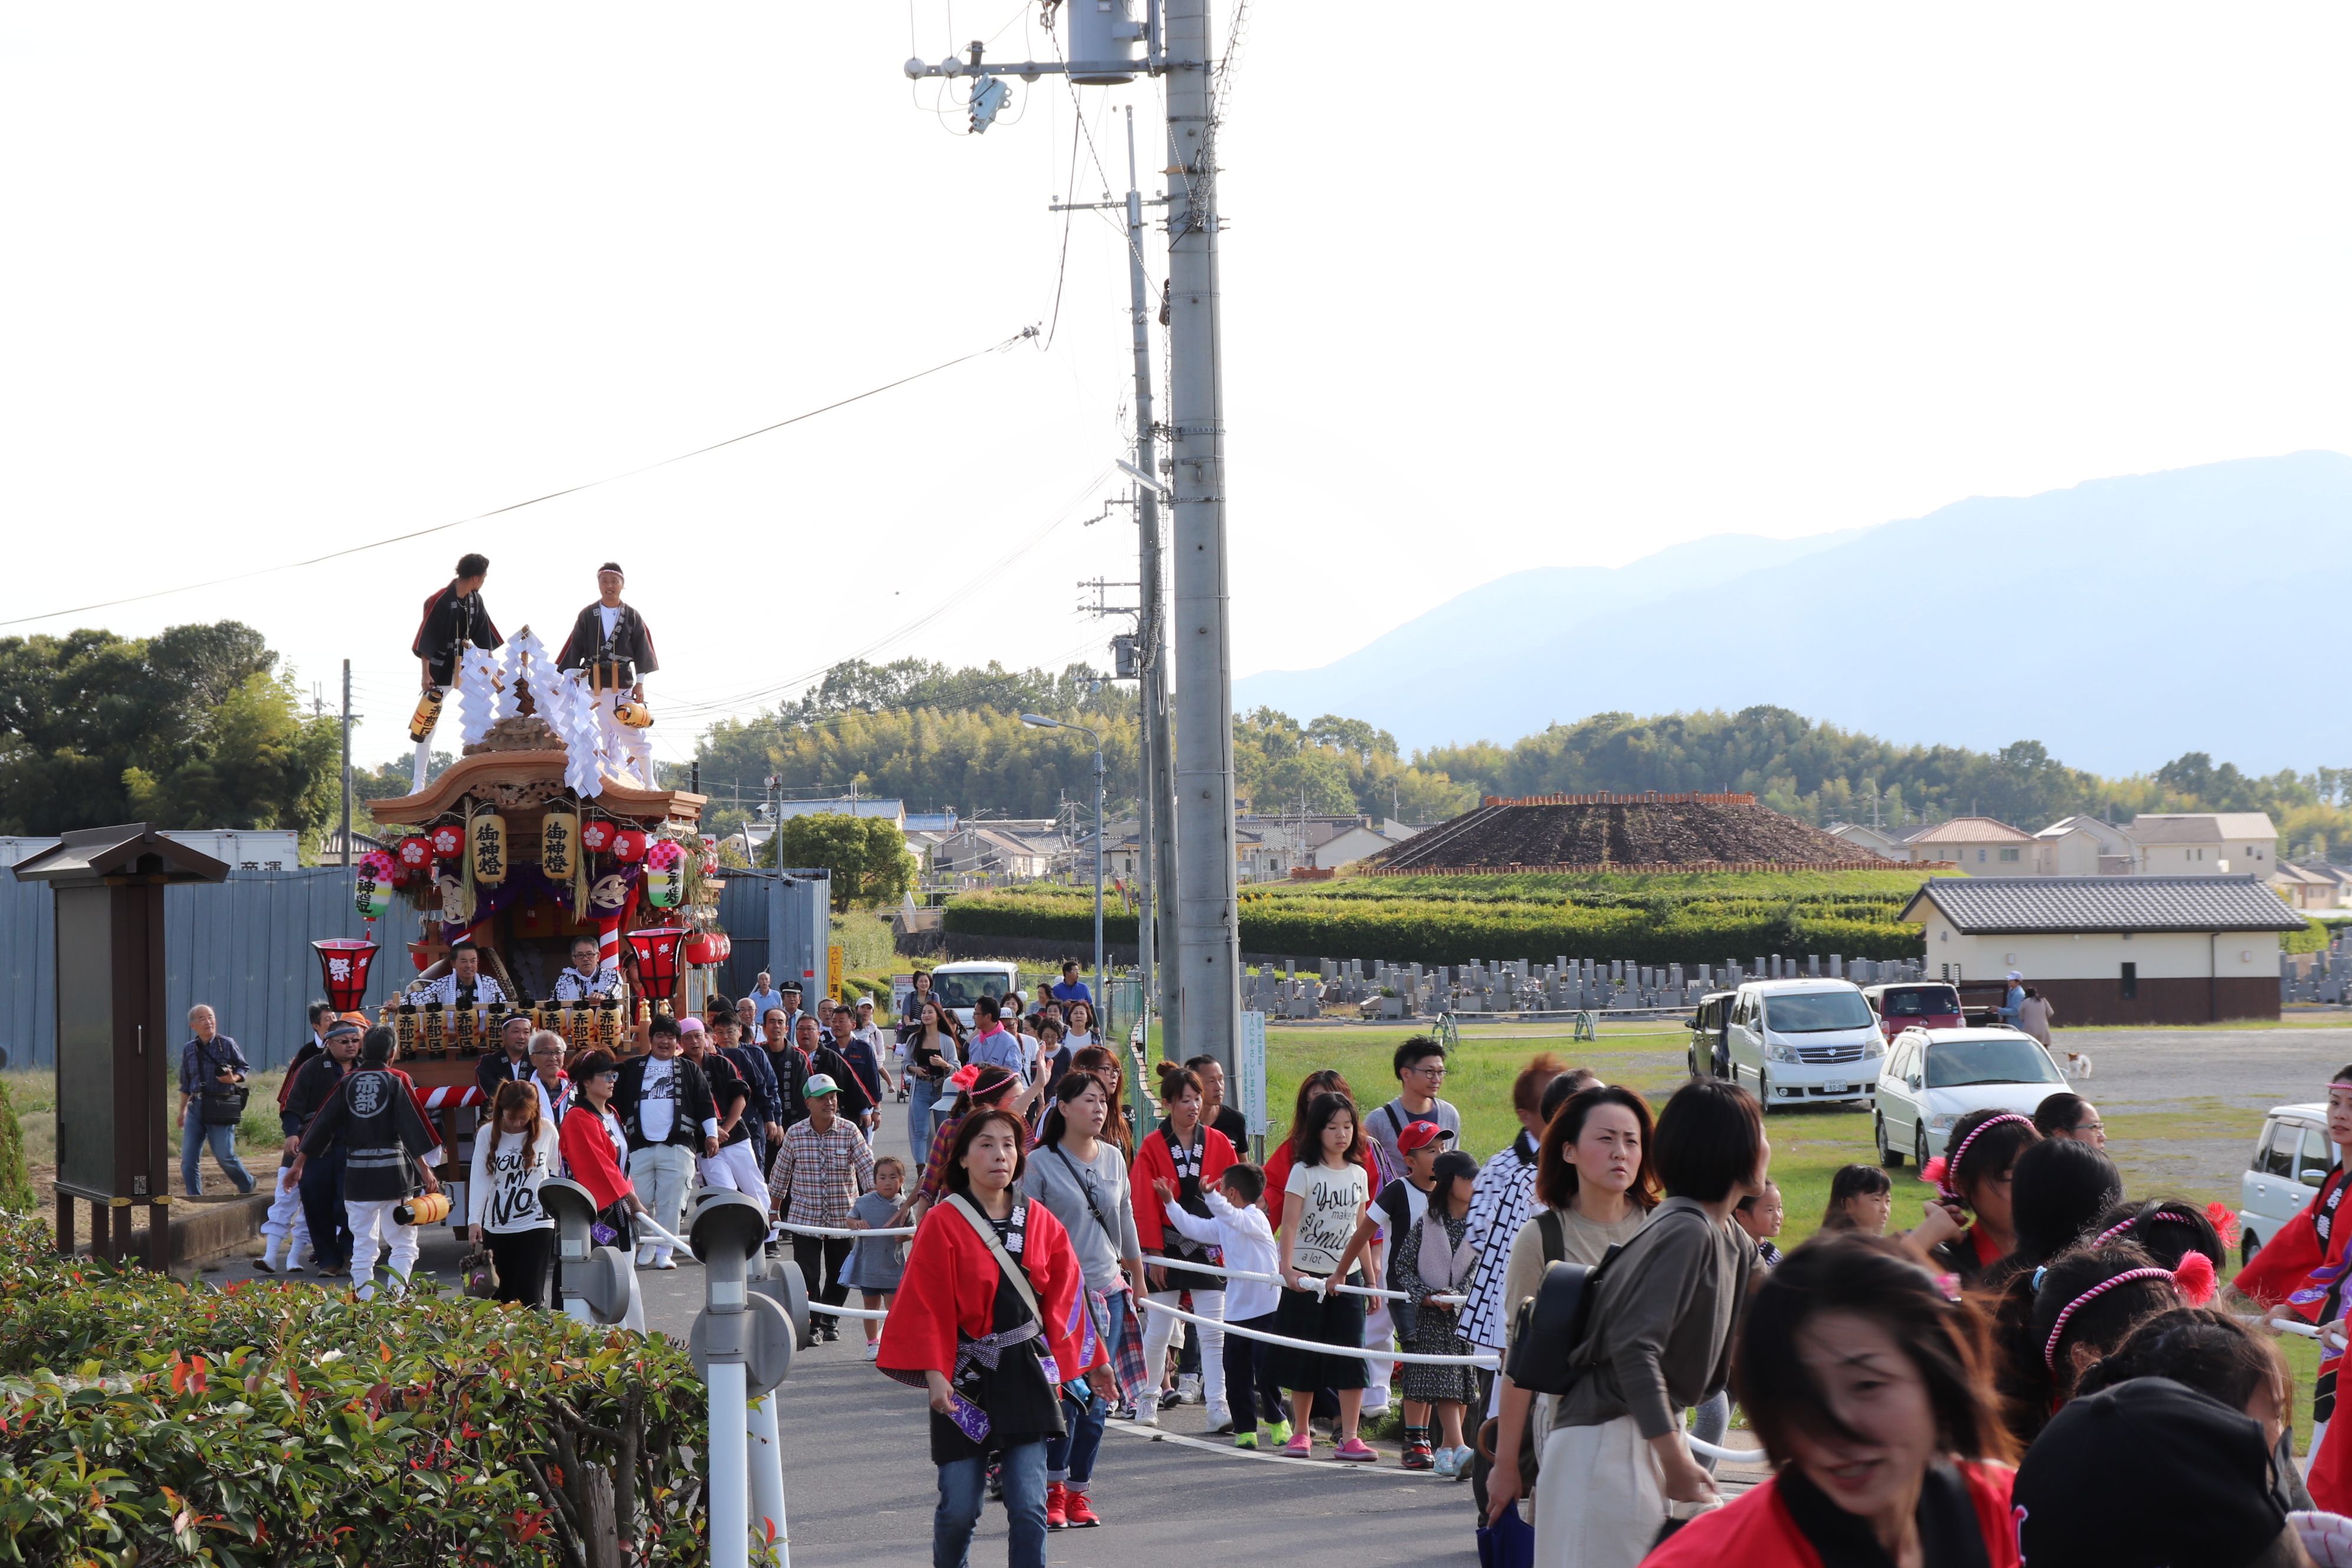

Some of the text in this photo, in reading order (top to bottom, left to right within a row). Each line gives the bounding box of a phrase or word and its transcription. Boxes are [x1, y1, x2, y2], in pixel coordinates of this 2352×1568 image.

[476, 823, 504, 876] 御神燈
[544, 822, 570, 874] 御神燈
[329, 958, 353, 982] 祭
[830, 947, 840, 1001] スピード落と
[398, 1015, 414, 1052] 赤部区
[426, 1012, 443, 1050] 赤部区
[457, 1012, 473, 1049] 赤部区
[573, 1012, 589, 1049] 赤部区
[599, 1011, 615, 1048] 赤部区
[355, 1074, 381, 1113] 赤部
[505, 1169, 533, 1190] MY
[1331, 1209, 1352, 1220] make
[1309, 1252, 1322, 1265] lot
